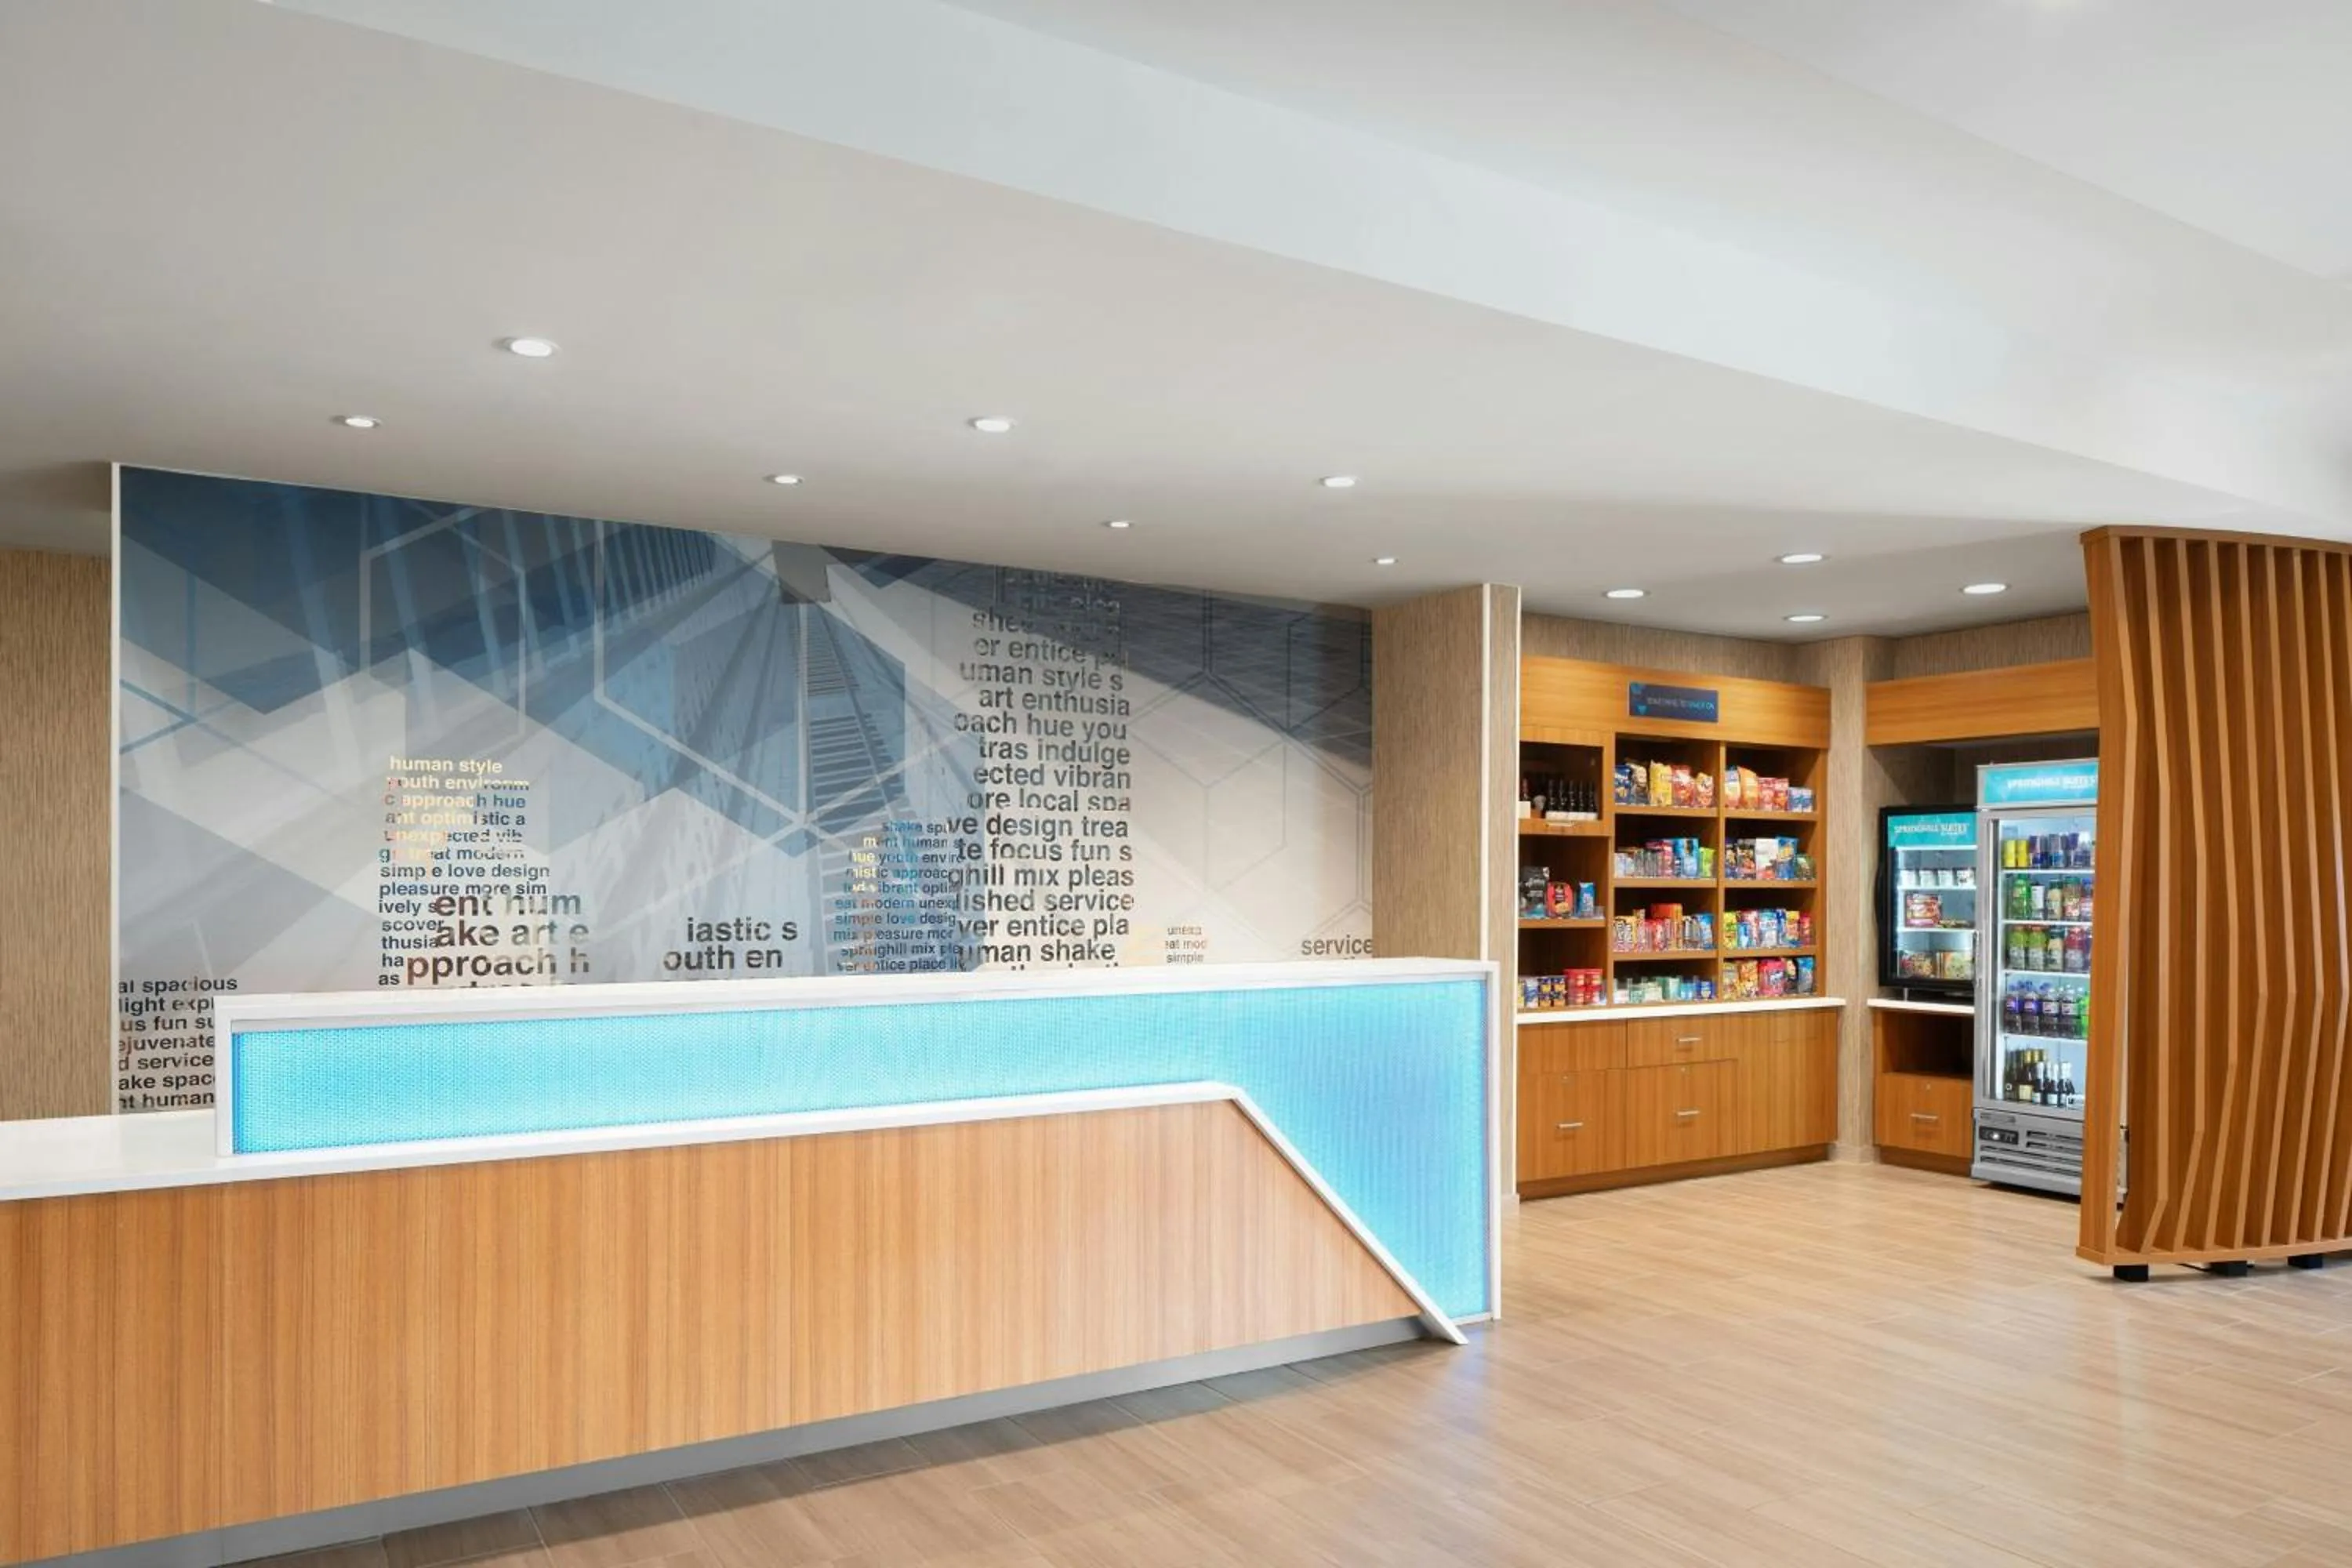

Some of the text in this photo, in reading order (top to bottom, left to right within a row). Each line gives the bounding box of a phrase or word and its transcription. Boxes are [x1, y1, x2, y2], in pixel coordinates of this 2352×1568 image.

[1008, 639, 1087, 663] entice
[960, 662, 1123, 692] uman style s
[978, 687, 1131, 717] art enthusia
[954, 711, 1127, 743] oach hue you
[1037, 739, 1131, 770] indulge
[390, 756, 503, 775] human style
[974, 764, 1131, 789] ected vibran
[402, 794, 487, 808] approach
[493, 794, 526, 808] hue
[967, 791, 1011, 809] ore
[1019, 789, 1079, 812] local
[516, 815, 525, 825] a
[986, 812, 1073, 842] design
[1082, 816, 1129, 837] trea
[990, 837, 1062, 862] focus
[1072, 840, 1110, 861] fun
[1120, 844, 1133, 861] s
[448, 864, 485, 877] love
[492, 864, 550, 880] design
[1014, 867, 1059, 886] mix
[1069, 865, 1134, 891] pleas
[379, 881, 546, 898] pleasure more sim
[956, 889, 1134, 911] lished service
[379, 900, 421, 916] ively
[435, 895, 492, 916] ent
[382, 919, 445, 931] scover
[687, 916, 798, 942] iastic s
[887, 913, 915, 924] love
[920, 913, 956, 927] desig
[957, 913, 1130, 941] ver entice pla
[436, 920, 589, 946] ake art e
[911, 943, 935, 953] mix
[1040, 939, 1116, 961] shake
[1301, 935, 1374, 955] service
[382, 953, 404, 967] ha
[407, 947, 589, 985] pproach h
[664, 946, 782, 970] outh en
[379, 975, 400, 985] as
[121, 1020, 146, 1031] us
[154, 1016, 187, 1031] fun
[137, 1053, 213, 1070] service
[118, 1075, 155, 1090] ake
[143, 1092, 214, 1108] human
